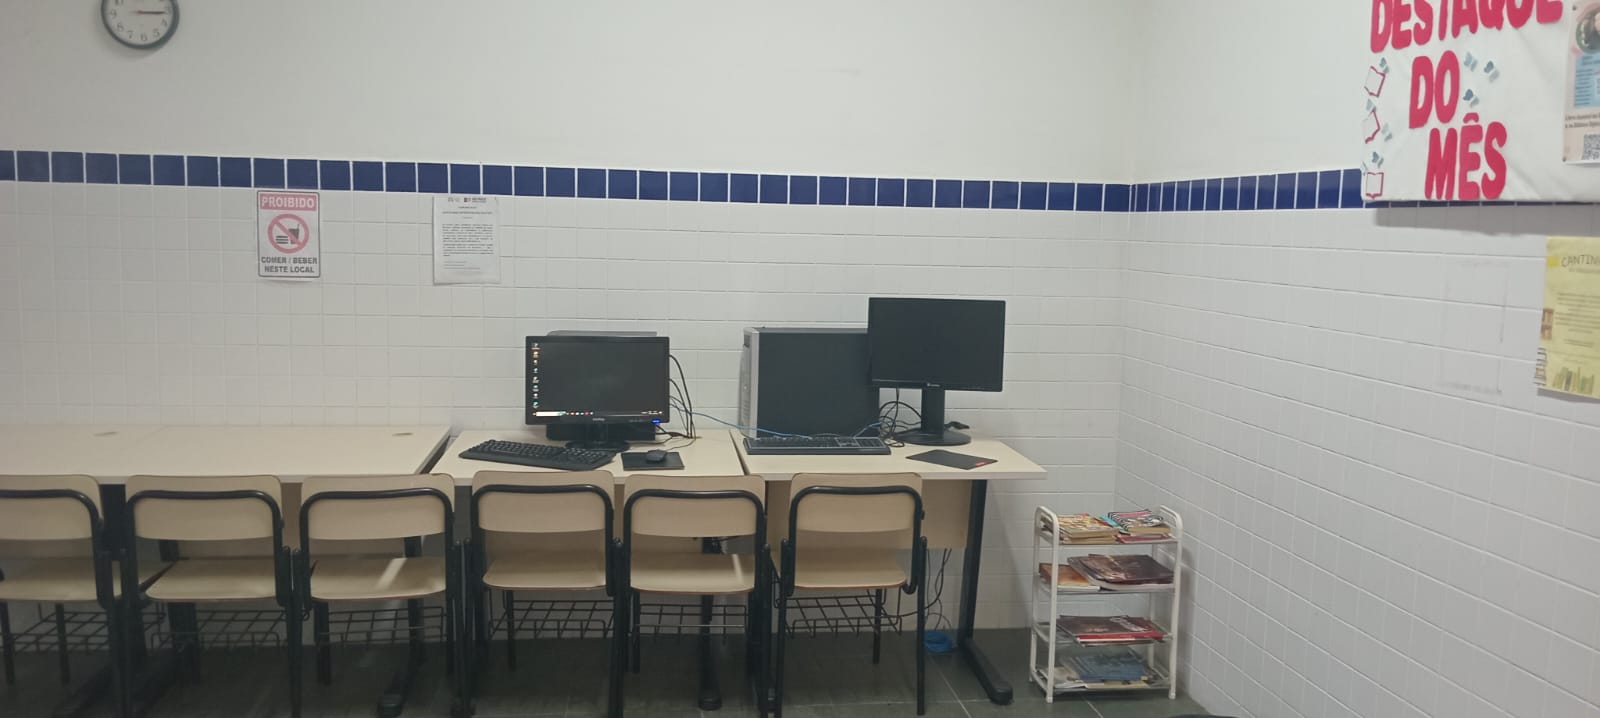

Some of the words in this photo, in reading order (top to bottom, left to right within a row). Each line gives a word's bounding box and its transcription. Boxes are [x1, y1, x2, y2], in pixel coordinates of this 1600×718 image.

[110, 9, 117, 19] 9
[126, 30, 134, 39] 7
[1409, 50, 1460, 129] DO
[1425, 112, 1507, 200] MÊS
[261, 196, 315, 208] PROIBIDO
[261, 256, 287, 264] COMER
[264, 265, 288, 273] NESTE
[290, 266, 314, 274] LOCAL
